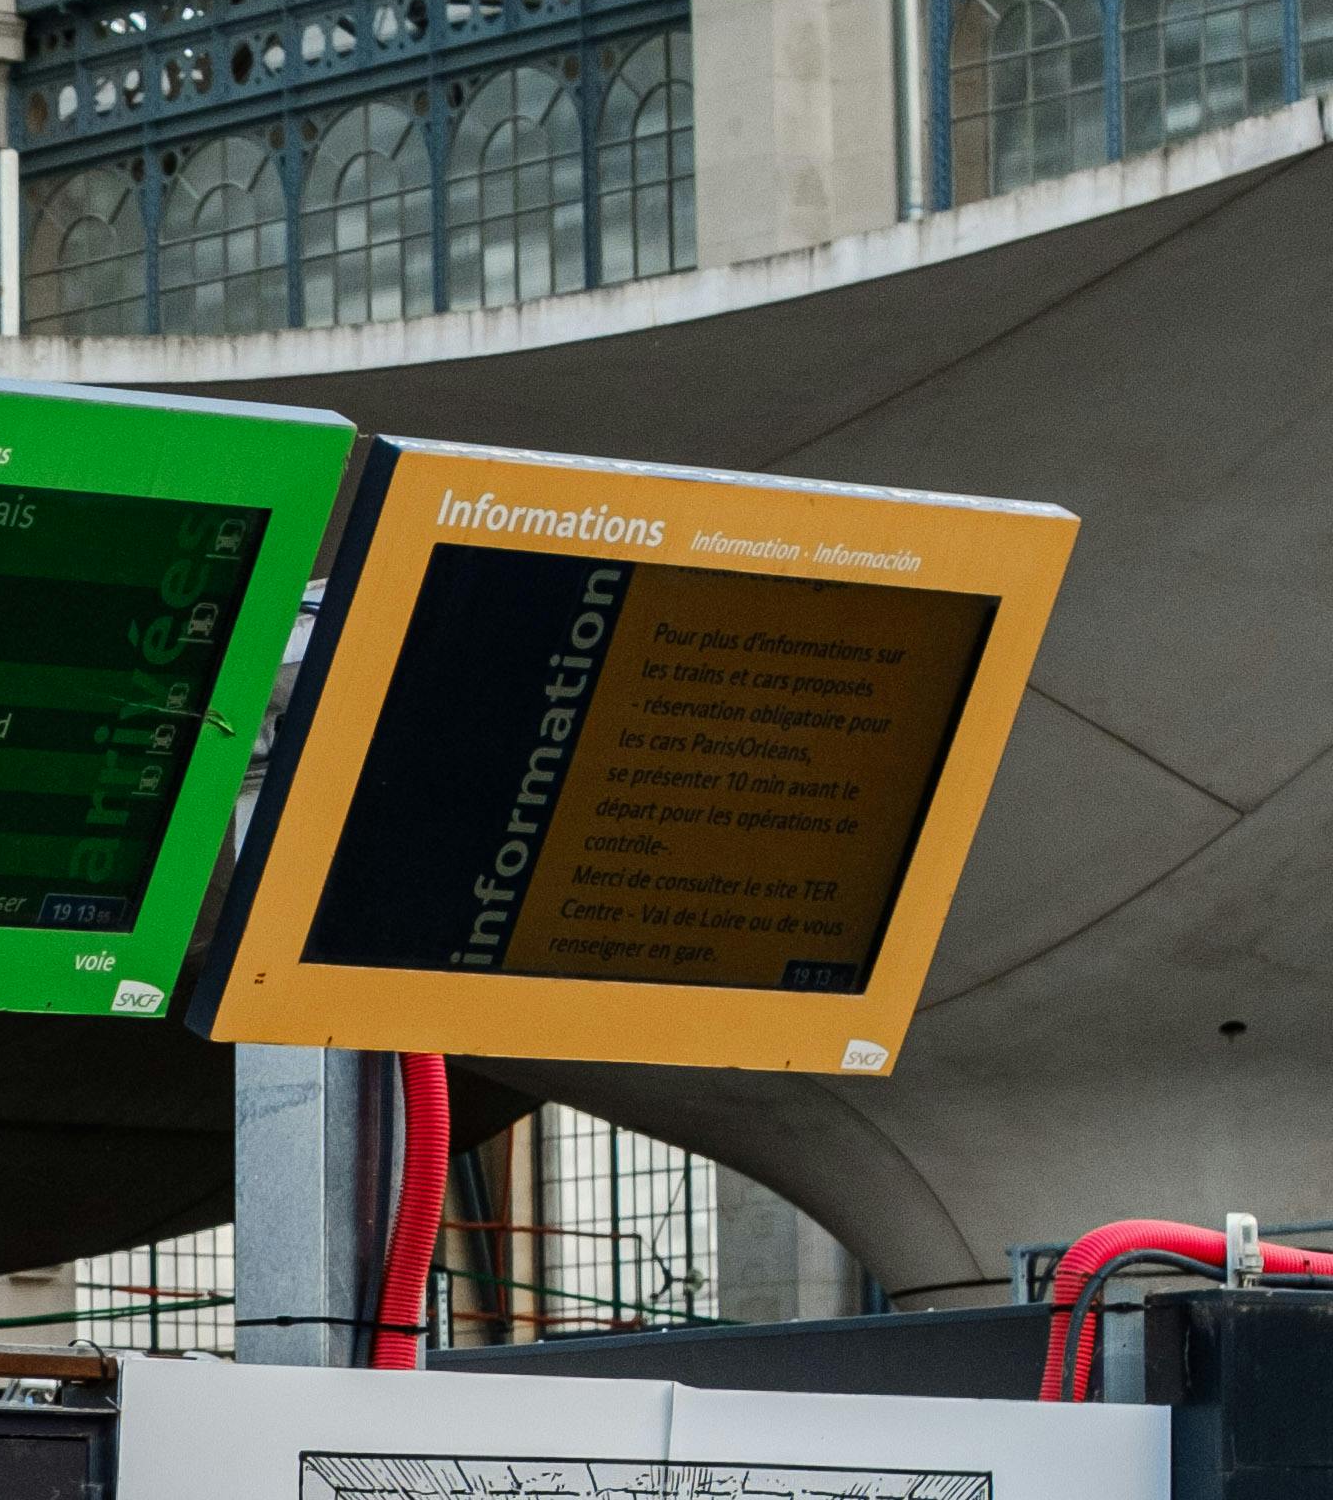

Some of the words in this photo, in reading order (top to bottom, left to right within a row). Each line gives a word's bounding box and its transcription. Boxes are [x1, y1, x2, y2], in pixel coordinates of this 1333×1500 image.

[436, 488, 667, 549] Informations
[690, 529, 801, 562] Information
[812, 540, 923, 574] Información
[653, 621, 697, 646] Pour
[698, 628, 740, 652] plus
[743, 631, 874, 663] d'informations
[673, 661, 725, 686] trains
[752, 671, 789, 691] cars
[791, 674, 875, 700] proposés
[643, 695, 747, 722] réservation
[749, 704, 847, 732] obligatoire
[847, 714, 893, 736] pour
[649, 732, 687, 753] cars
[450, 568, 621, 966] information
[629, 766, 720, 791] présenter
[750, 772, 786, 795] min
[787, 778, 840, 799] avant
[595, 798, 658, 823] départ
[658, 804, 703, 825] pour
[736, 808, 833, 834] opérations
[571, 864, 625, 888] Merci
[654, 870, 741, 896] consulter
[763, 878, 798, 900] site
[802, 877, 839, 901] TER
[560, 898, 624, 923] Centre
[640, 902, 670, 922] Val
[699, 907, 748, 931] Loire
[803, 918, 844, 937] vous
[74, 949, 117, 973] voie
[548, 935, 647, 962] renseigner
[115, 993, 161, 1009] SNCF
